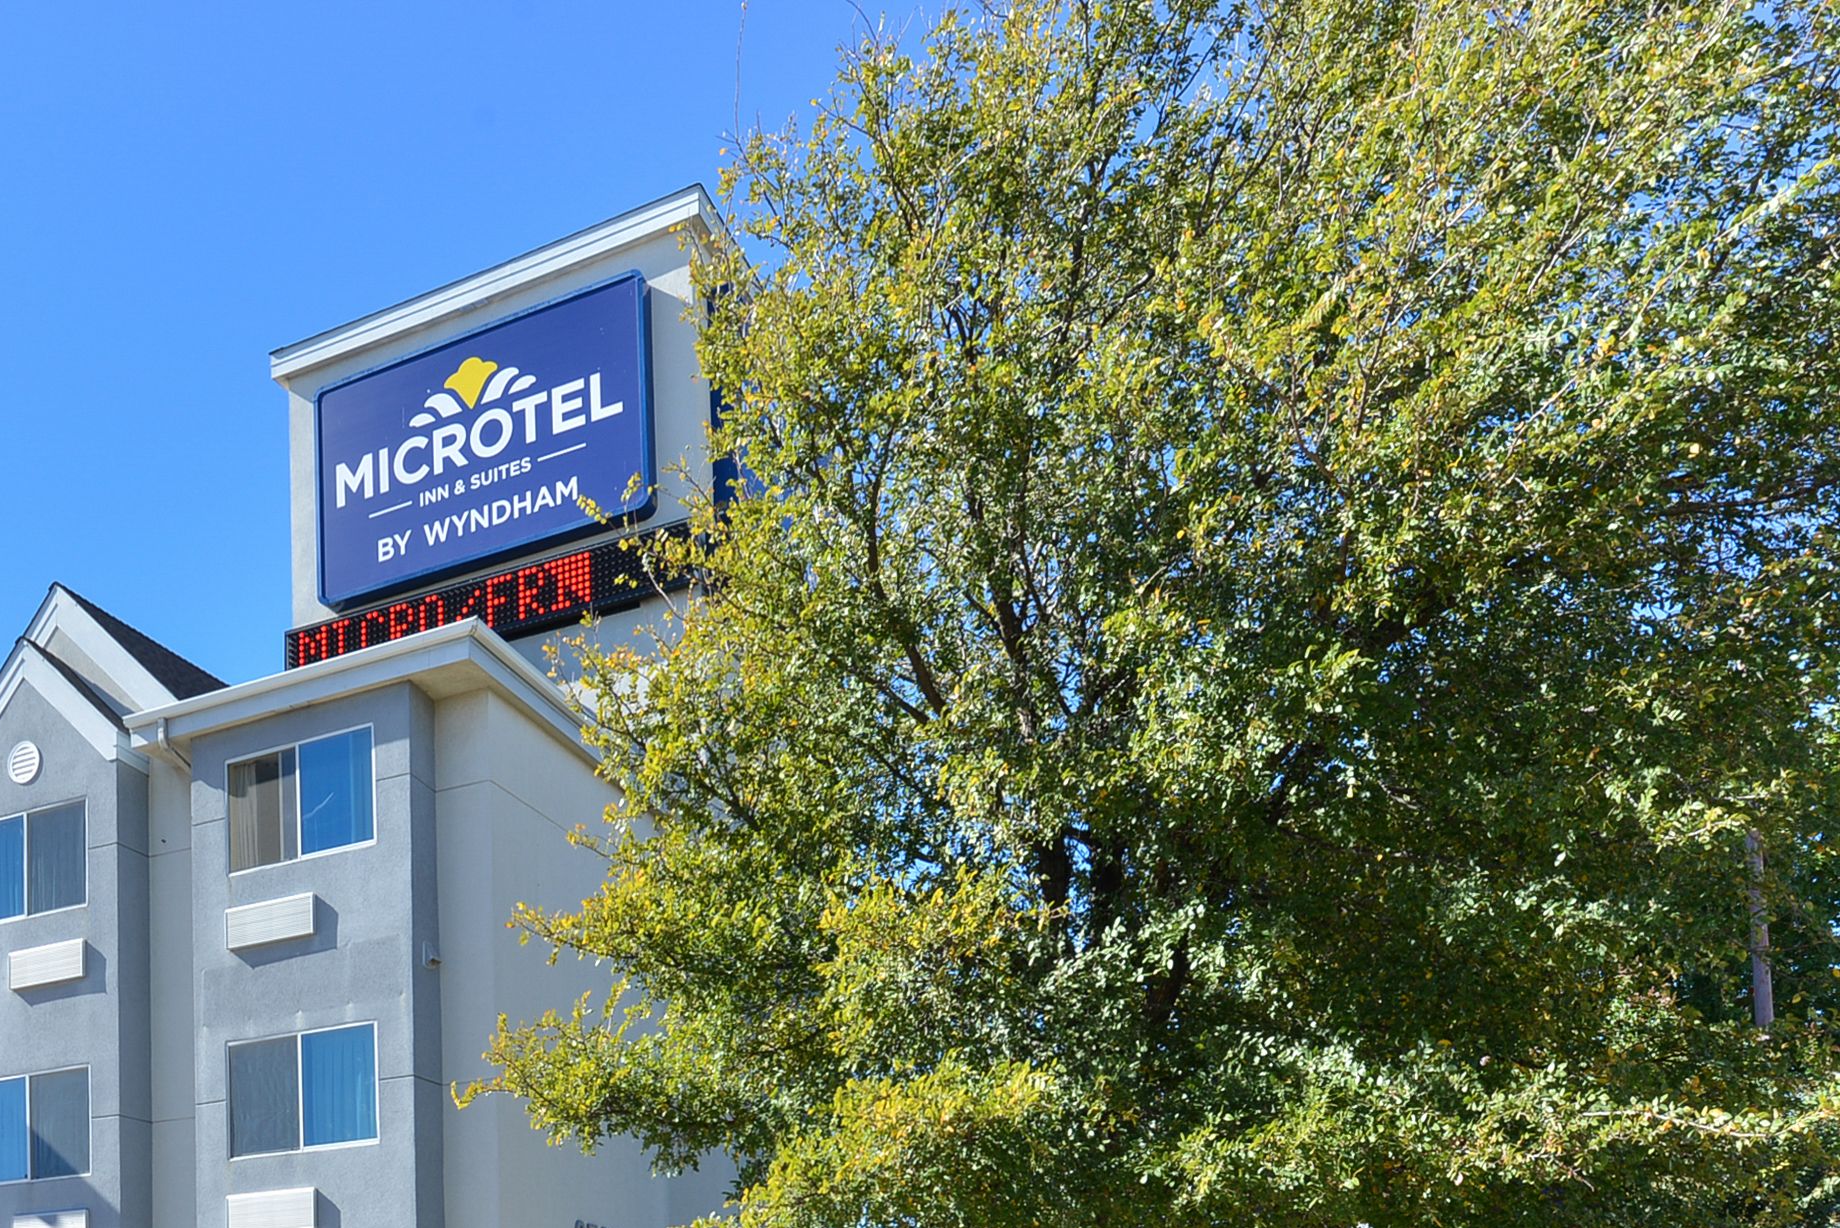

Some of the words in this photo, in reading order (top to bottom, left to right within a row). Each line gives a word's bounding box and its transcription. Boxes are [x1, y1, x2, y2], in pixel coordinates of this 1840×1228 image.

[335, 372, 624, 508] MICROTEL
[419, 484, 449, 507] INN
[453, 479, 466, 495] &
[470, 456, 532, 489] SUITES
[377, 529, 412, 563] BY
[423, 476, 579, 546] WYNDHAM
